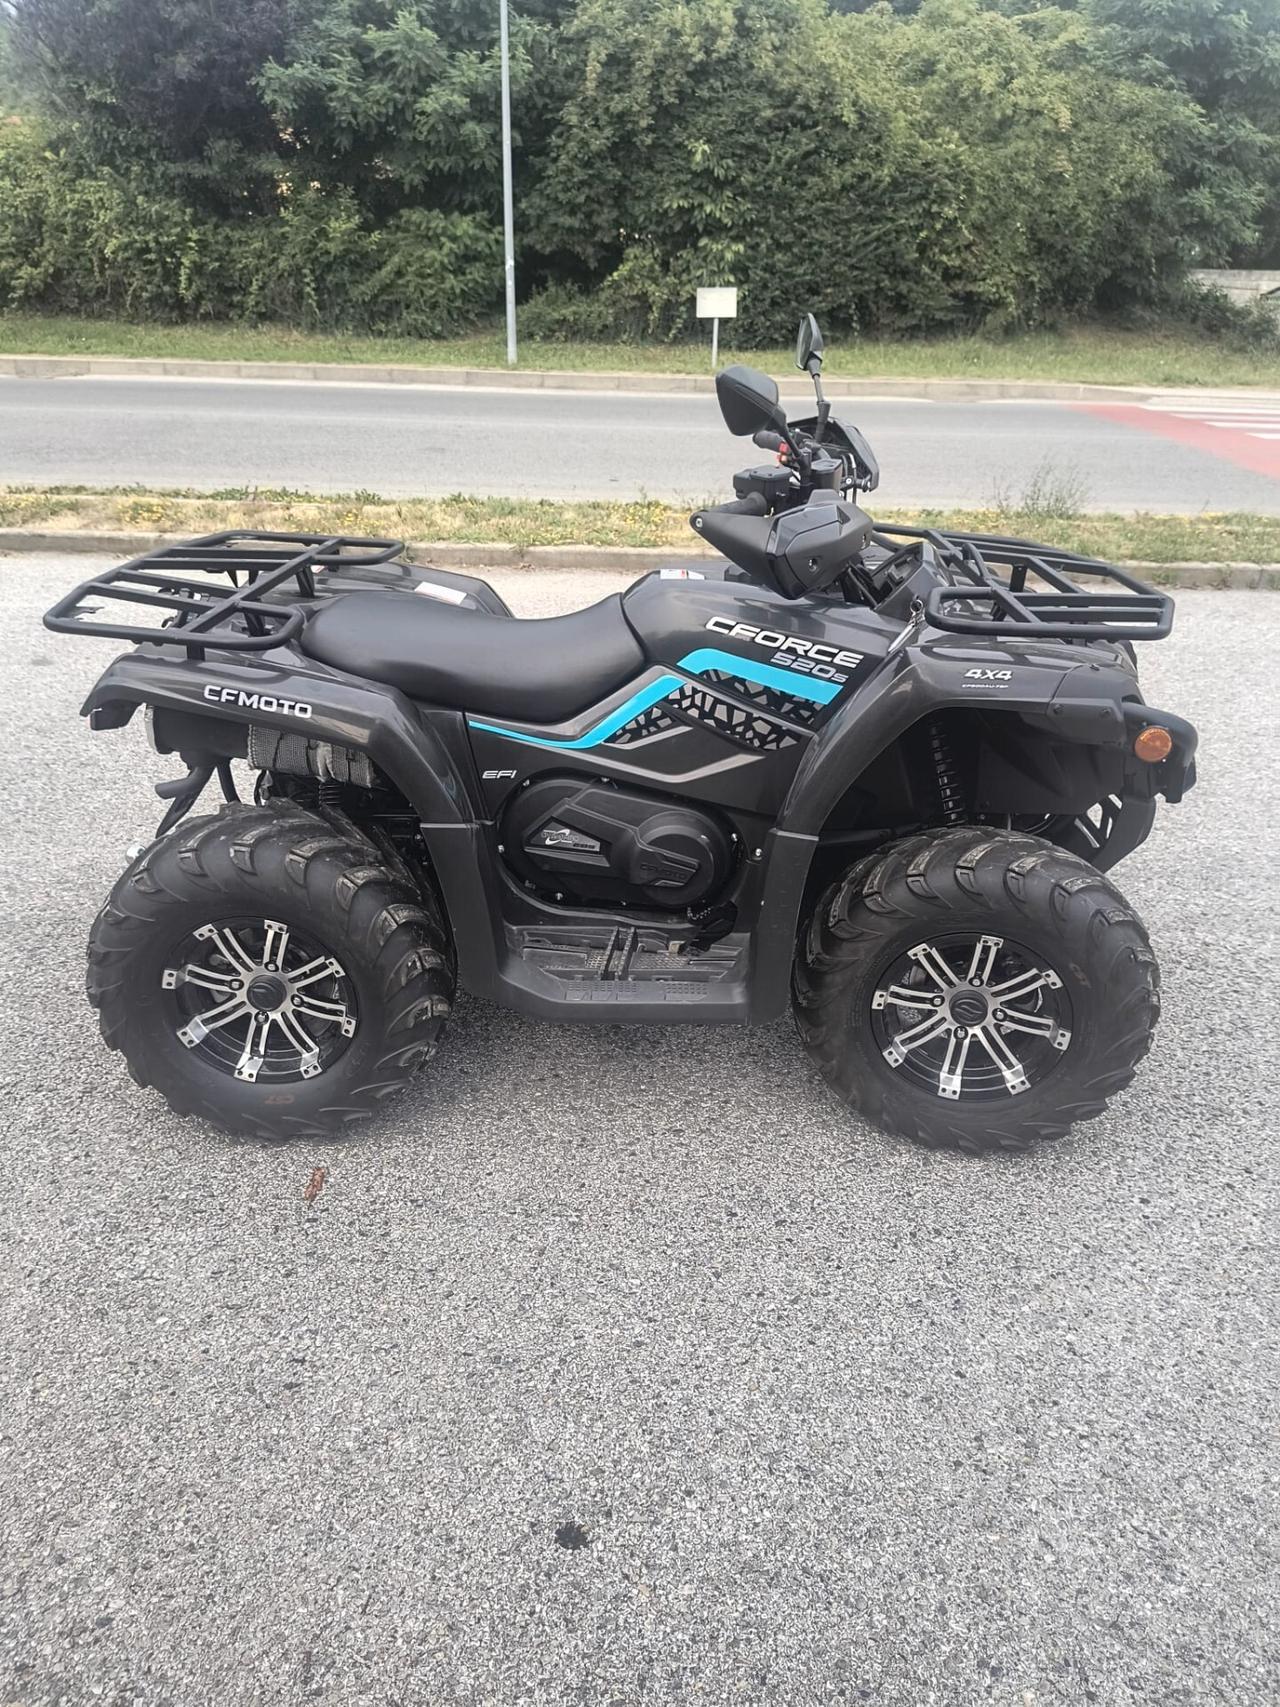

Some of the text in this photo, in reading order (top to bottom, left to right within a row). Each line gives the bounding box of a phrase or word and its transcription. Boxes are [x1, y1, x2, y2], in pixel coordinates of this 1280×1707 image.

[705, 616, 864, 668] CFORCE
[203, 684, 313, 719] CFMOTO
[482, 770, 517, 779] EFI
